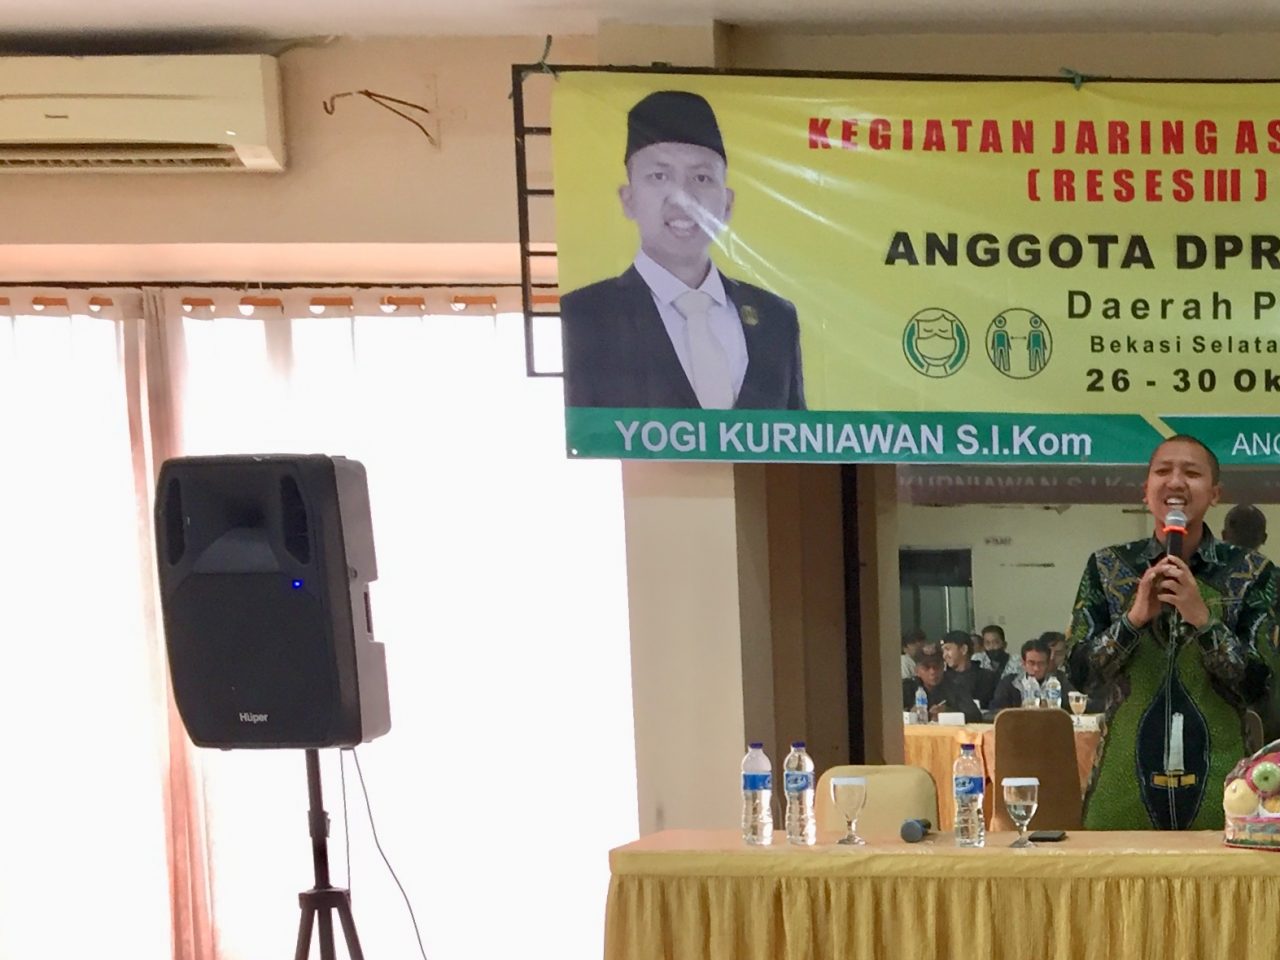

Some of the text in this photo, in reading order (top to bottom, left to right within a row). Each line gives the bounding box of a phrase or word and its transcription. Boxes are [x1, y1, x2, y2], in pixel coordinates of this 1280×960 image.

[807, 116, 1034, 154] KEGIATAN
[1051, 118, 1218, 156] JARING
[884, 231, 1156, 270] ANGGOTA
[1068, 290, 1232, 320] Daerah
[1090, 335, 1181, 354] Bekasi
[1086, 368, 1131, 393] 26
[1172, 368, 1217, 393] 30
[615, 421, 1092, 456] YOGI KURNIAWAN S.I.Kom
